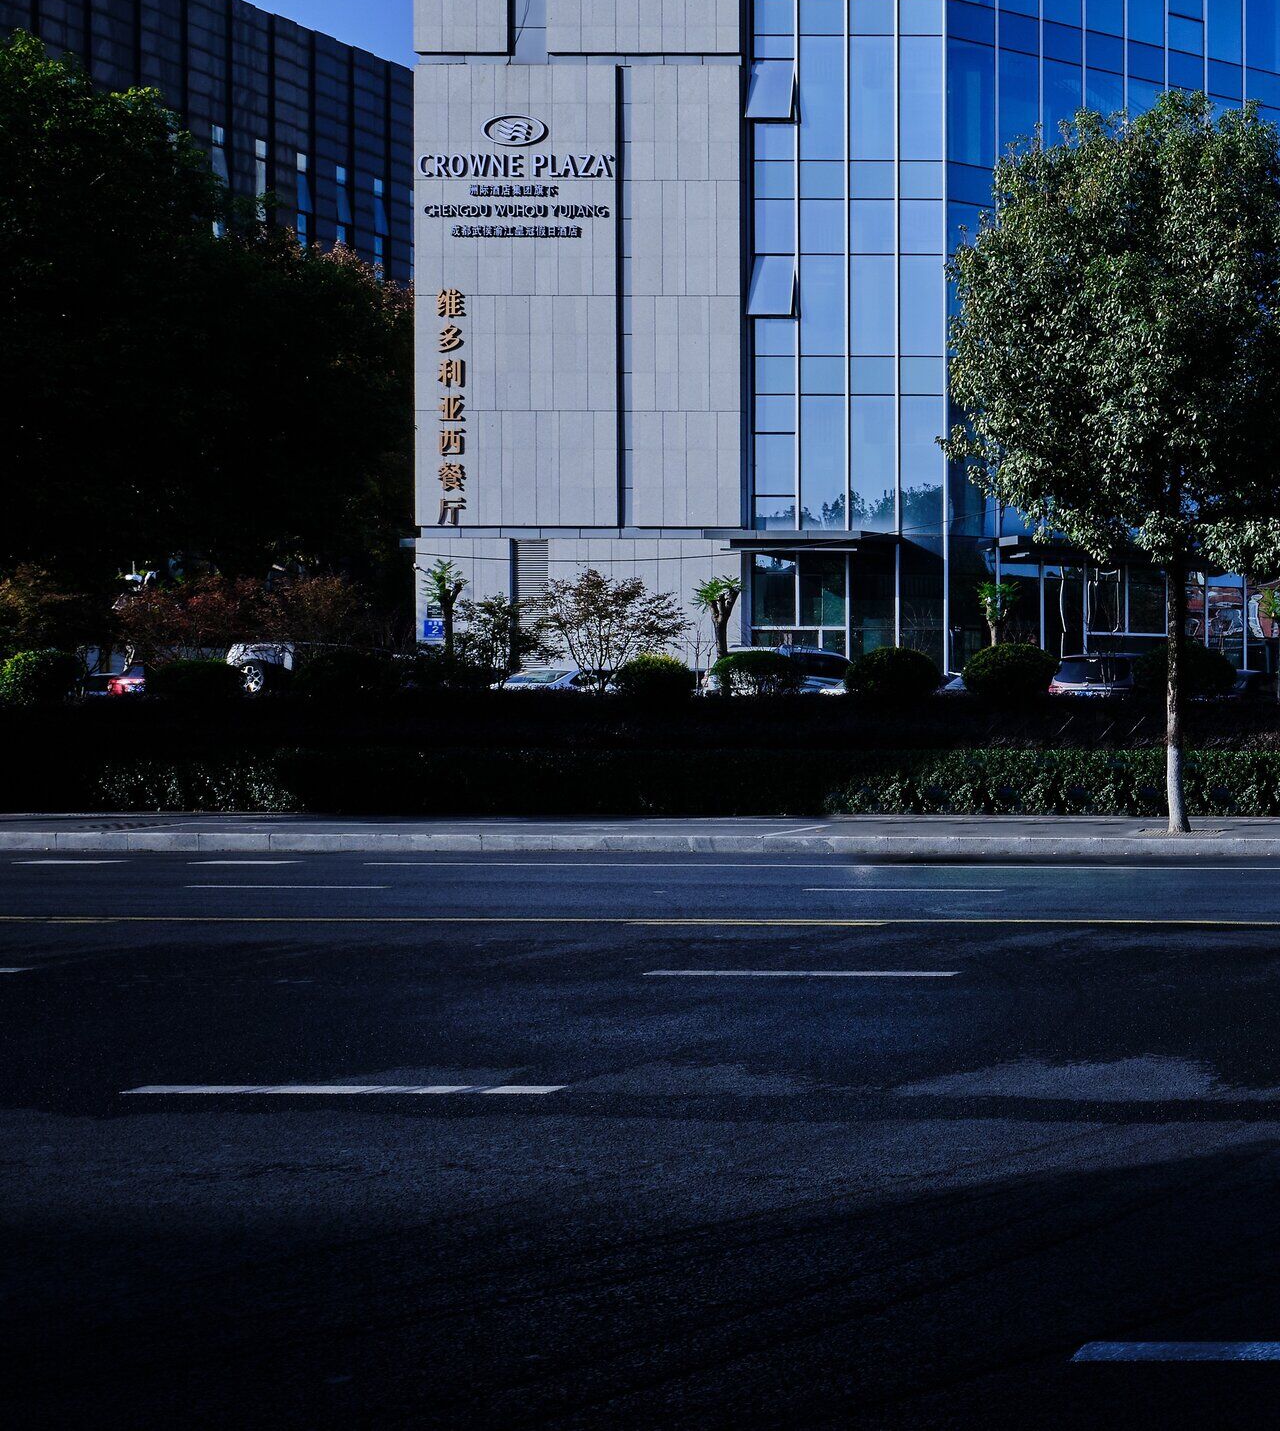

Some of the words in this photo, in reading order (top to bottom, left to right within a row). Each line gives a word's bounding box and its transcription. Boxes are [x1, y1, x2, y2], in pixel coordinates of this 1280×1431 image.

[417, 154, 522, 177] CROWNE
[424, 205, 489, 218] CHENGDU
[494, 205, 545, 218] WUHOU
[550, 205, 609, 219] YUJIANG
[437, 288, 466, 526] 维多利亚西餐厅
[431, 625, 440, 634] 2
